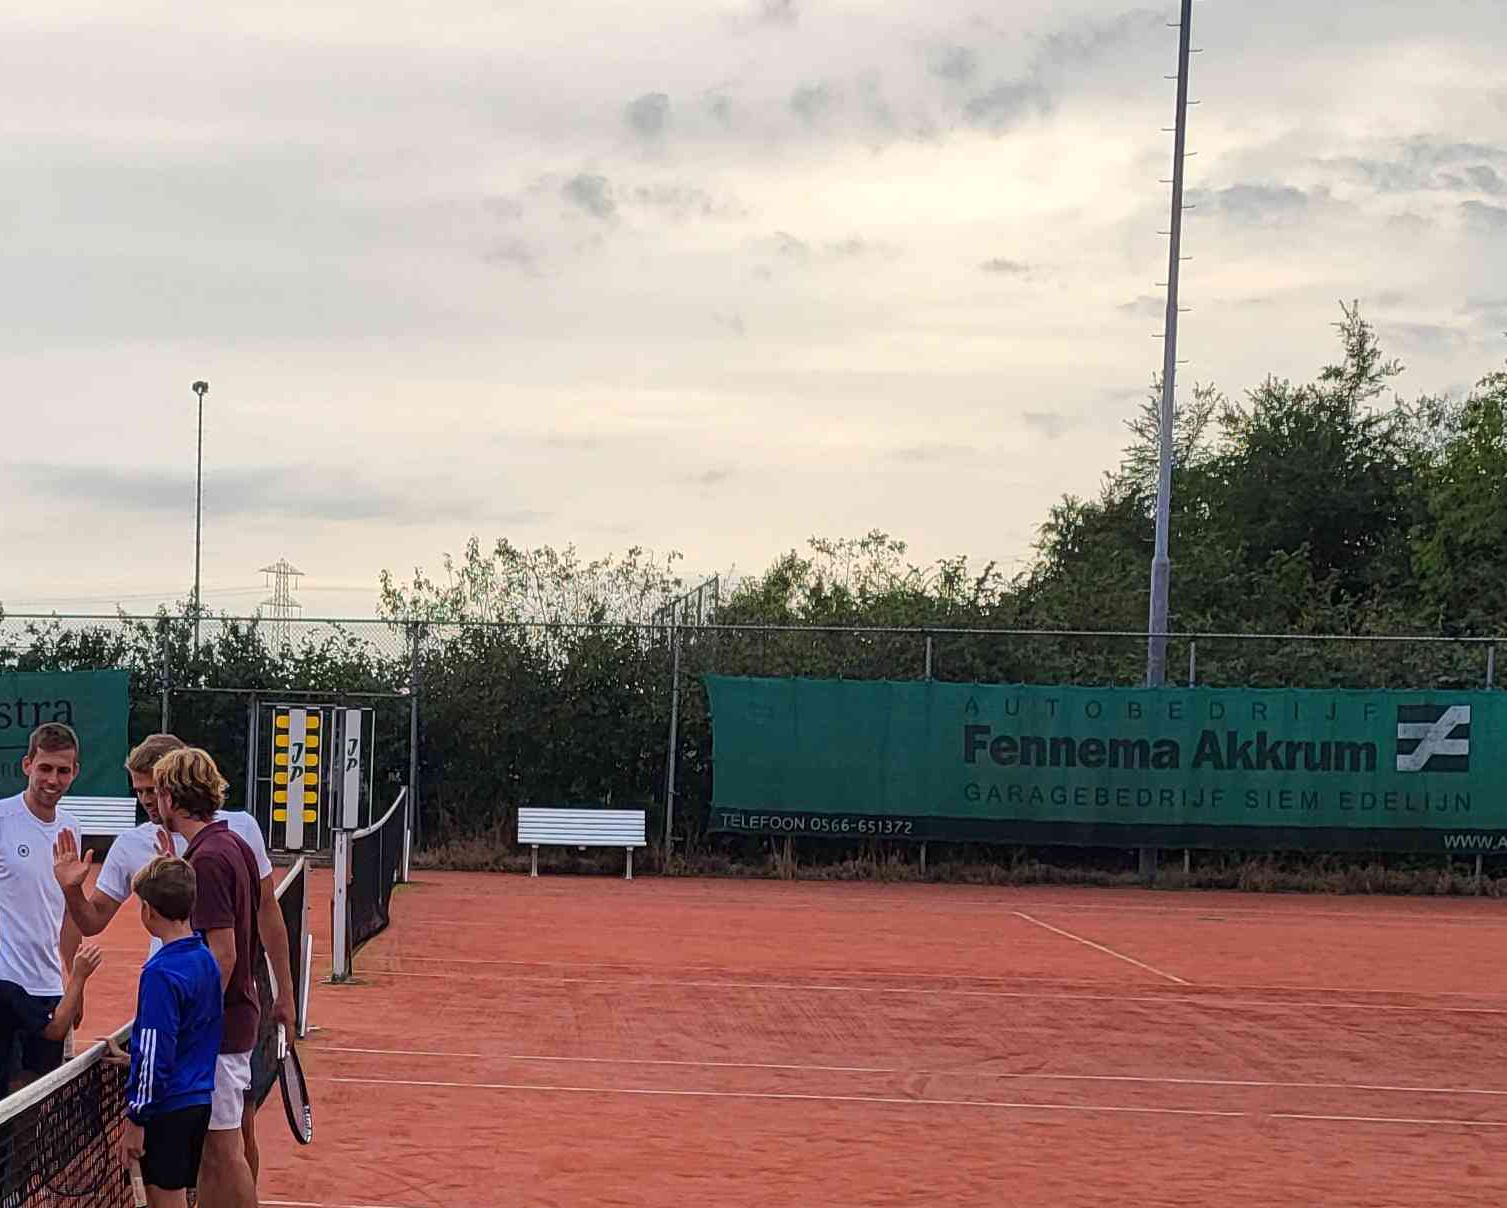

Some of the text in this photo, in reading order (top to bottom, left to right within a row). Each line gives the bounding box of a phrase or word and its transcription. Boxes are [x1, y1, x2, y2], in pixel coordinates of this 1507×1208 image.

[964, 696, 1381, 721] AUTOBEDRIJF
[963, 724, 1378, 773] Fennema Akkrum
[963, 783, 1472, 812] GARAGEBEDRIJF SIEM EDELIJN
[720, 812, 913, 834] TELEFOON 0566-651372
